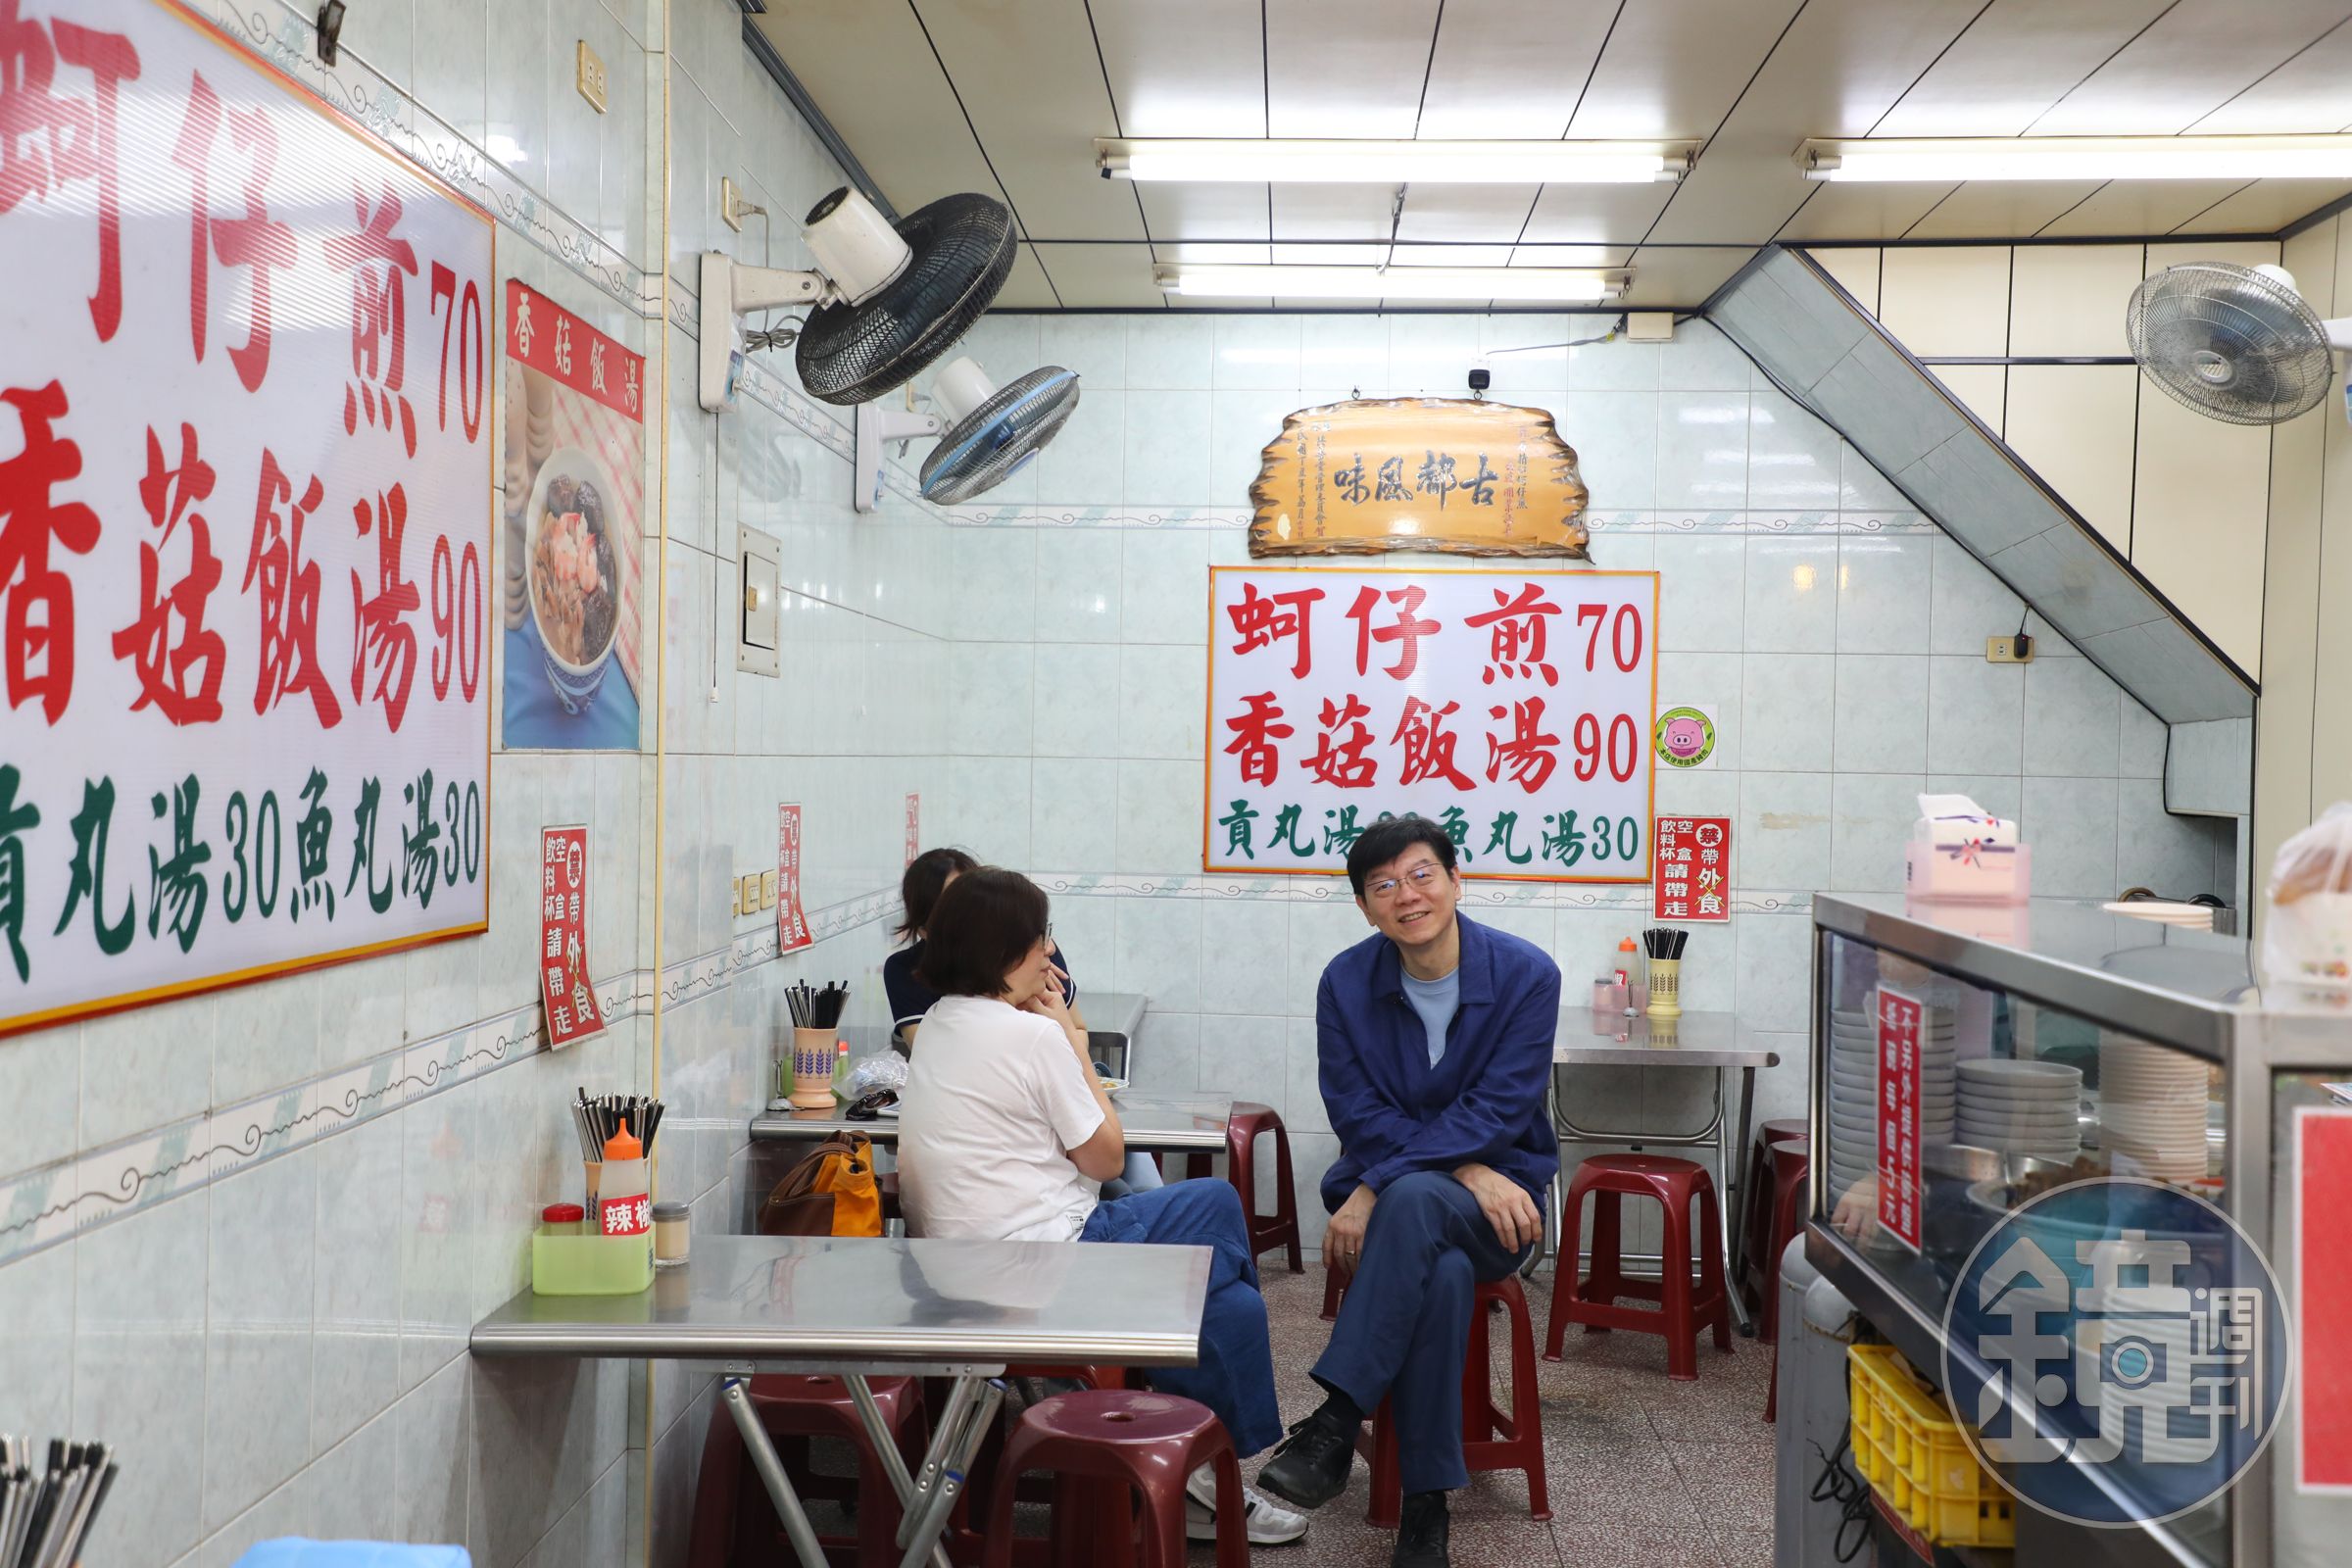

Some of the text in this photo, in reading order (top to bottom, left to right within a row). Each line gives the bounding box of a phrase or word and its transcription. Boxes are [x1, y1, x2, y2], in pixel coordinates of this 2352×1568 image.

[514, 292, 639, 414] 香菇飯湯
[1334, 451, 1499, 511] 古都風味
[0, 378, 480, 733] 香菇飯湯90
[1227, 582, 1642, 687] 蚵仔煎70
[1224, 691, 1638, 794] 香菇飯湯90
[1664, 863, 1689, 916] 請帶走
[1697, 825, 1723, 914] 禁帶外食
[547, 928, 573, 1037] 請帶走
[566, 843, 595, 1024] 禁帶外食
